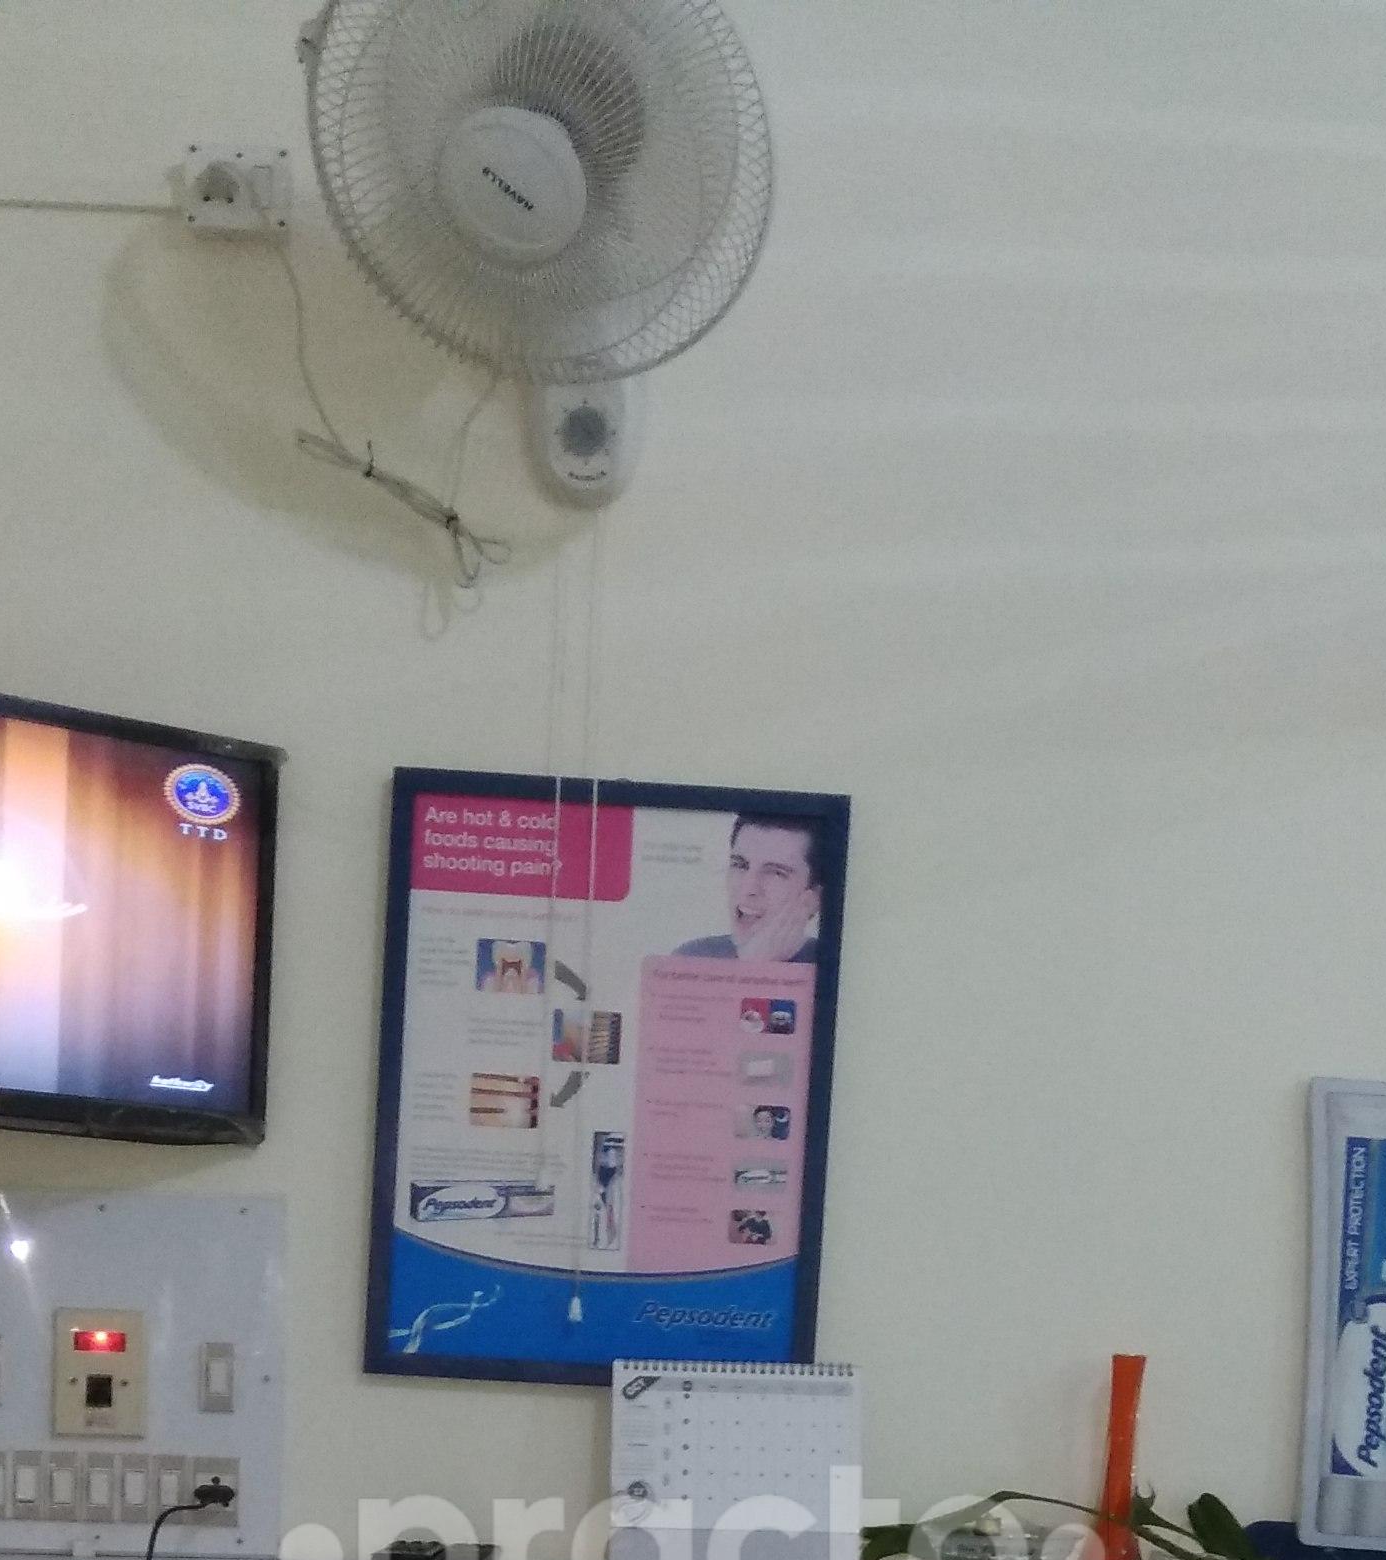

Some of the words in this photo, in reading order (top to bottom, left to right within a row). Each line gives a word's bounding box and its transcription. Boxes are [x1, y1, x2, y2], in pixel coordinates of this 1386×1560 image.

[425, 806, 458, 825] Are
[463, 808, 493, 827] hot
[499, 810, 512, 828] &
[517, 813, 560, 831] cold
[424, 829, 479, 849] foods
[483, 834, 558, 857] causing
[422, 852, 506, 877] shooting
[510, 858, 564, 877] pain?
[1348, 1146, 1368, 1236] PROTECTION
[423, 1196, 498, 1216] Pepsodent
[1344, 1238, 1362, 1291] EXPERT
[631, 1299, 775, 1331] Pepsodent
